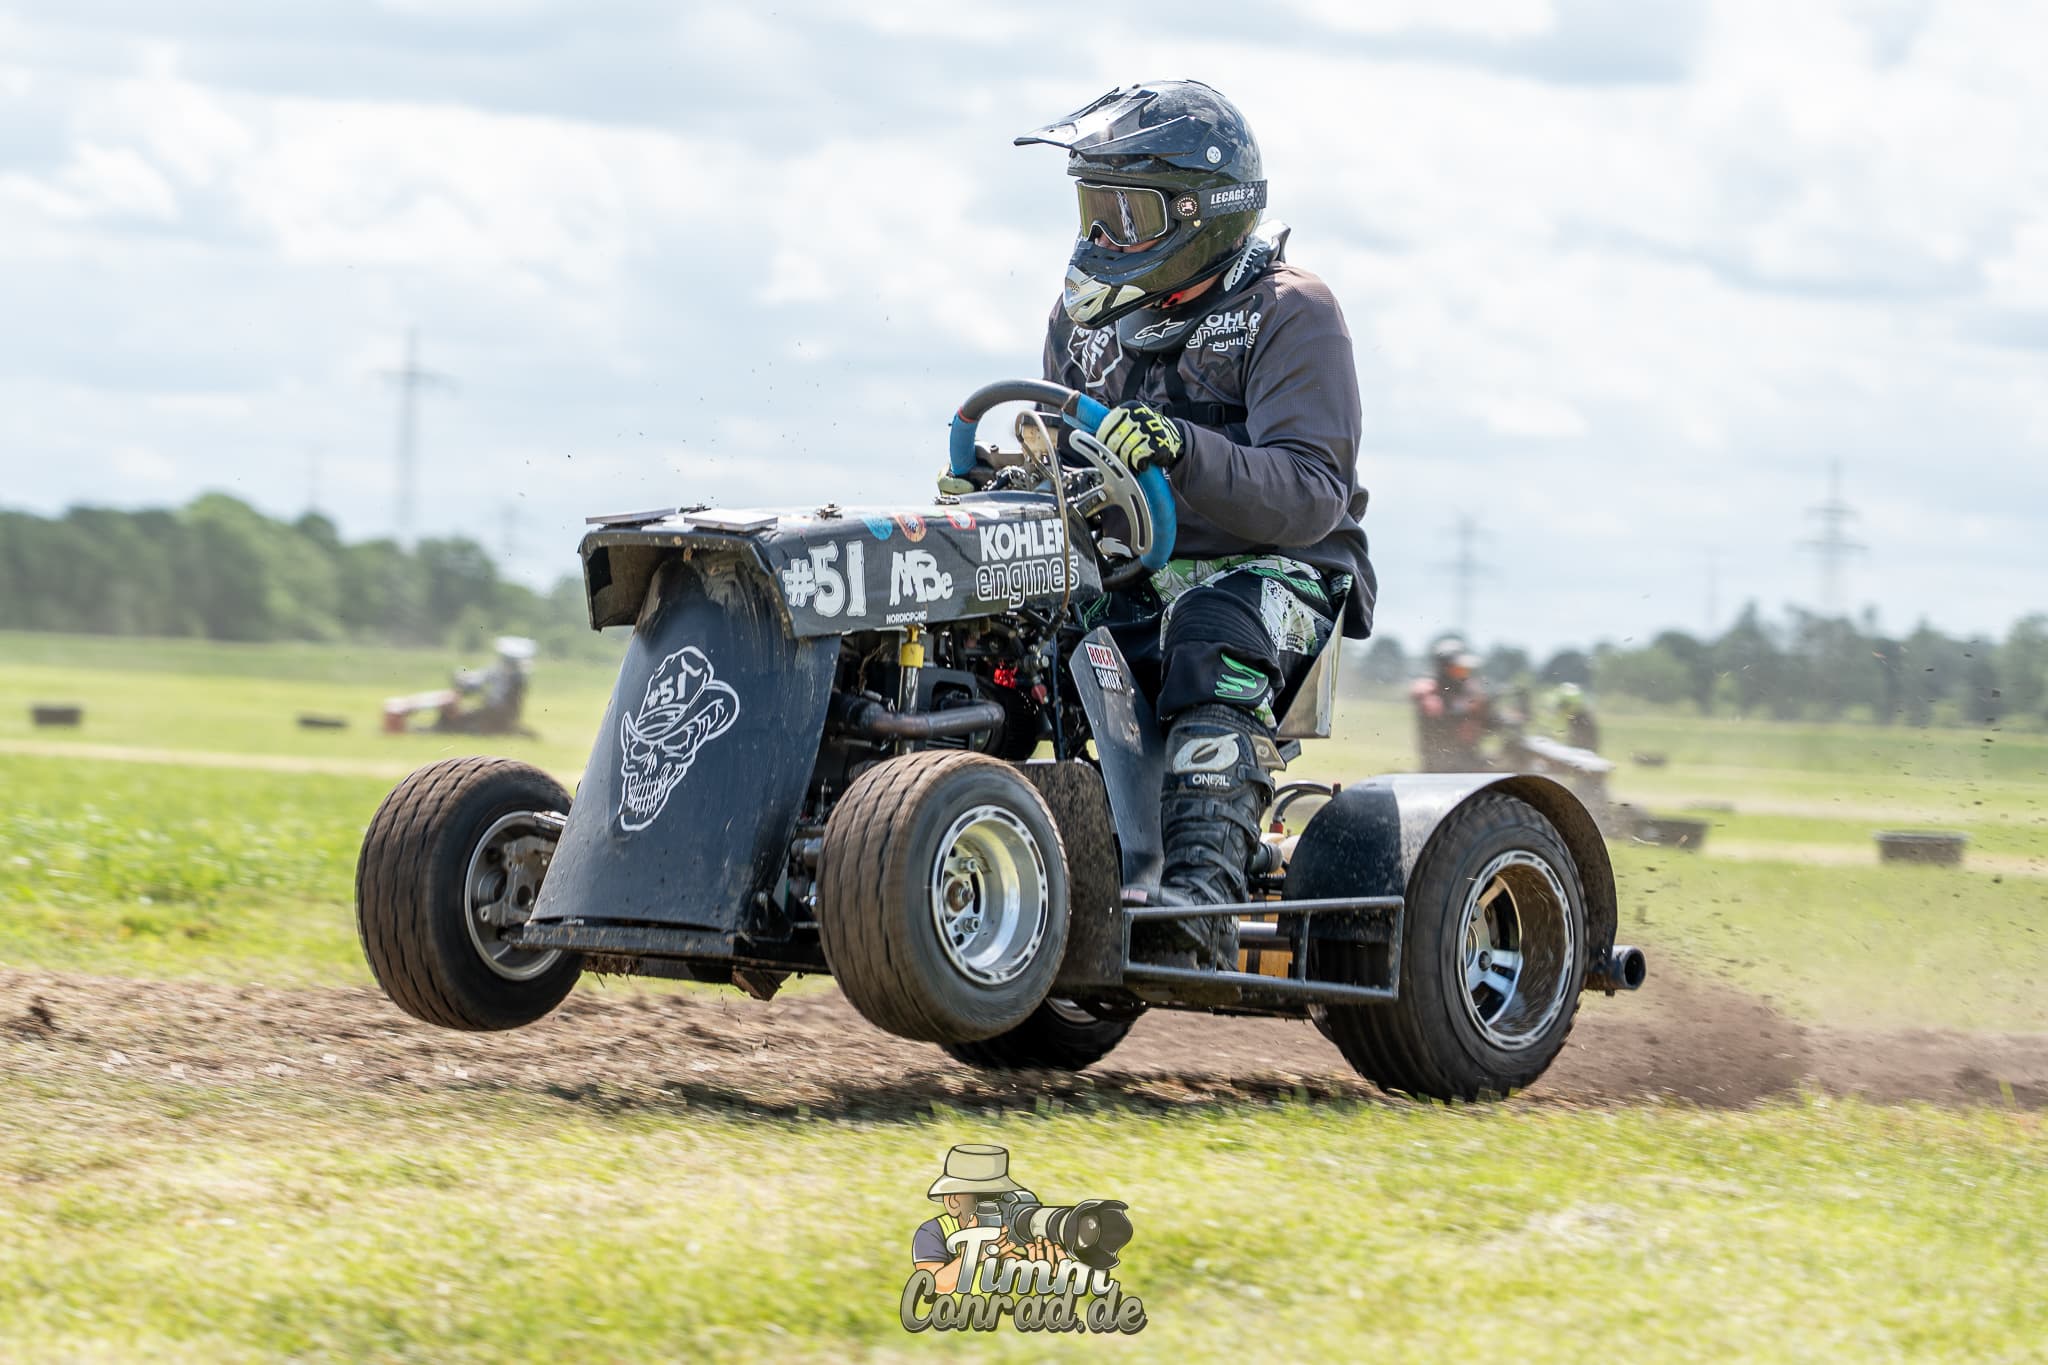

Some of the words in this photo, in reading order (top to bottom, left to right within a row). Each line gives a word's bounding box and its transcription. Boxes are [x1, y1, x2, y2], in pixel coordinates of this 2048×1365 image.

[1202, 310, 1261, 331] OHLR
[783, 540, 867, 618] #51
[976, 555, 1080, 609] engines
